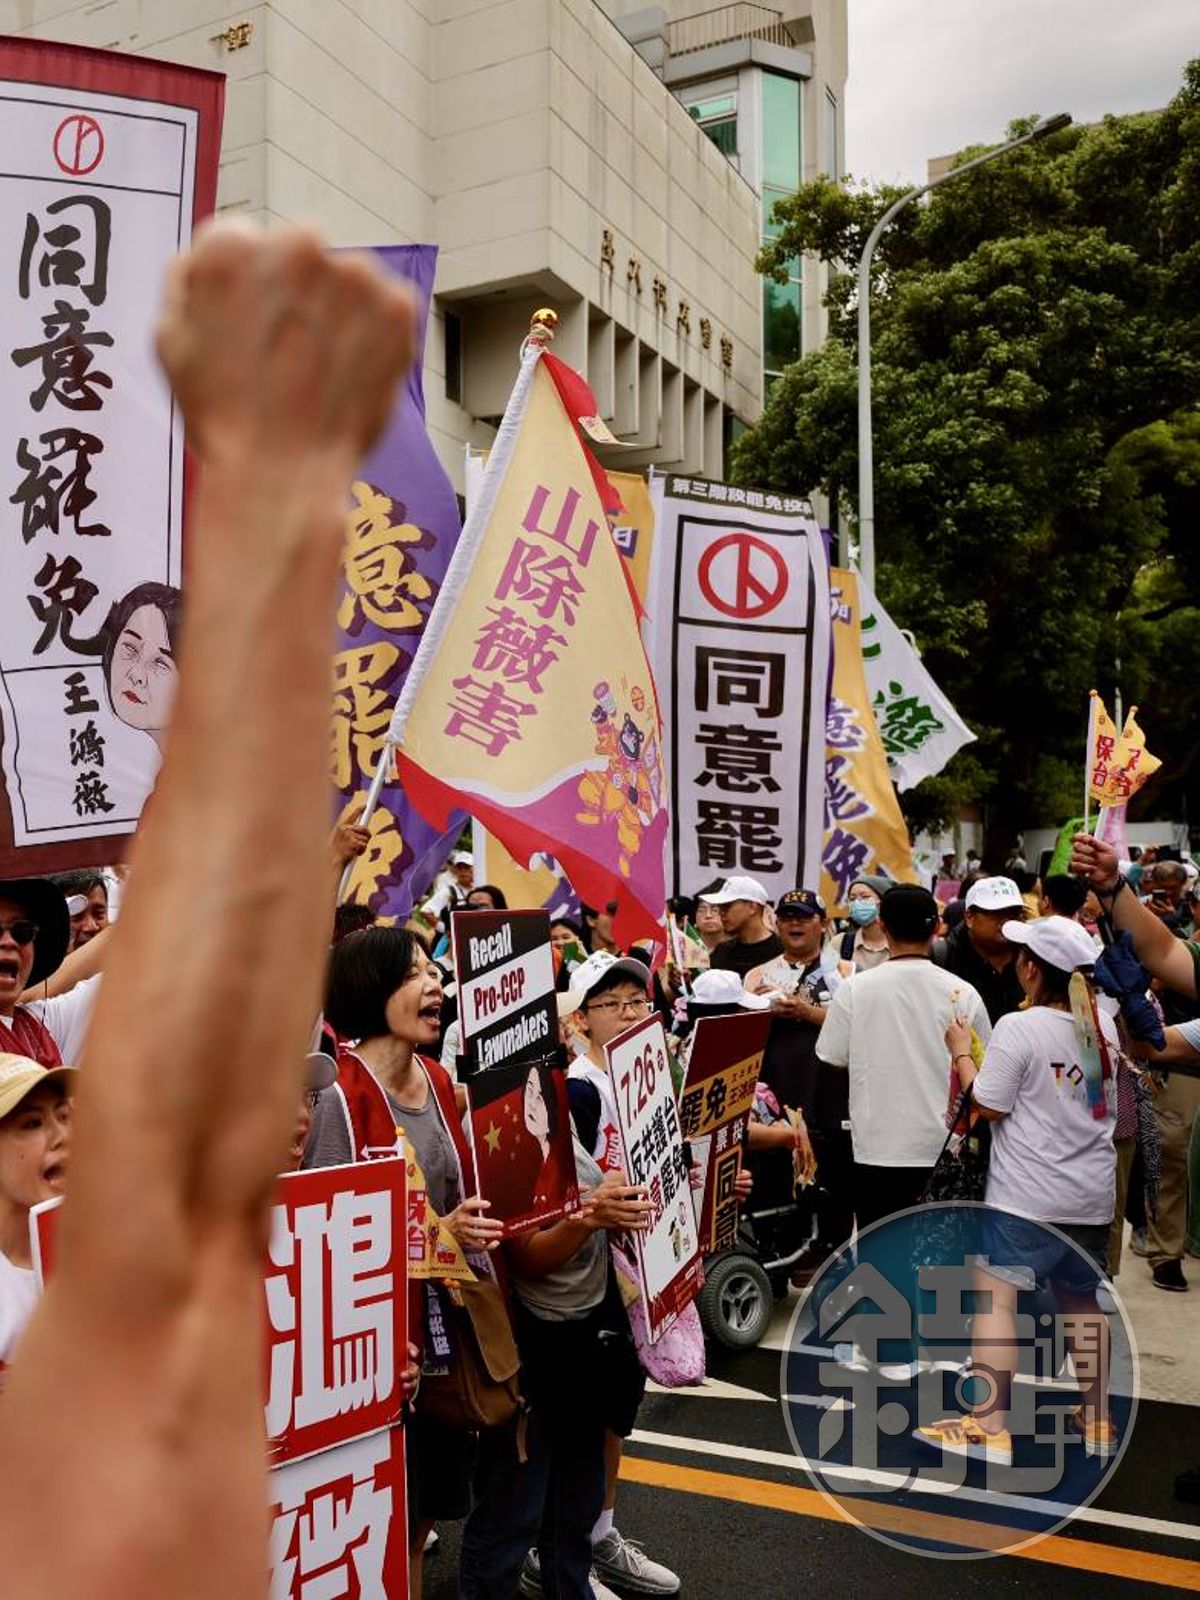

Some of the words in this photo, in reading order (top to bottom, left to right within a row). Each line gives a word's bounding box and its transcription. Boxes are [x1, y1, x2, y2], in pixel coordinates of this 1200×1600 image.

[9, 194, 114, 657] 同意罷免
[444, 484, 600, 757] 山除薇害
[63, 672, 114, 817] 王鴻薇
[693, 646, 786, 896] 同意罷
[469, 922, 513, 972] Recall
[473, 967, 526, 1021] Pro-CCP
[476, 1009, 549, 1070] Lawmakers
[621, 1042, 656, 1129] 7.26
[680, 1077, 728, 1138] 罷免
